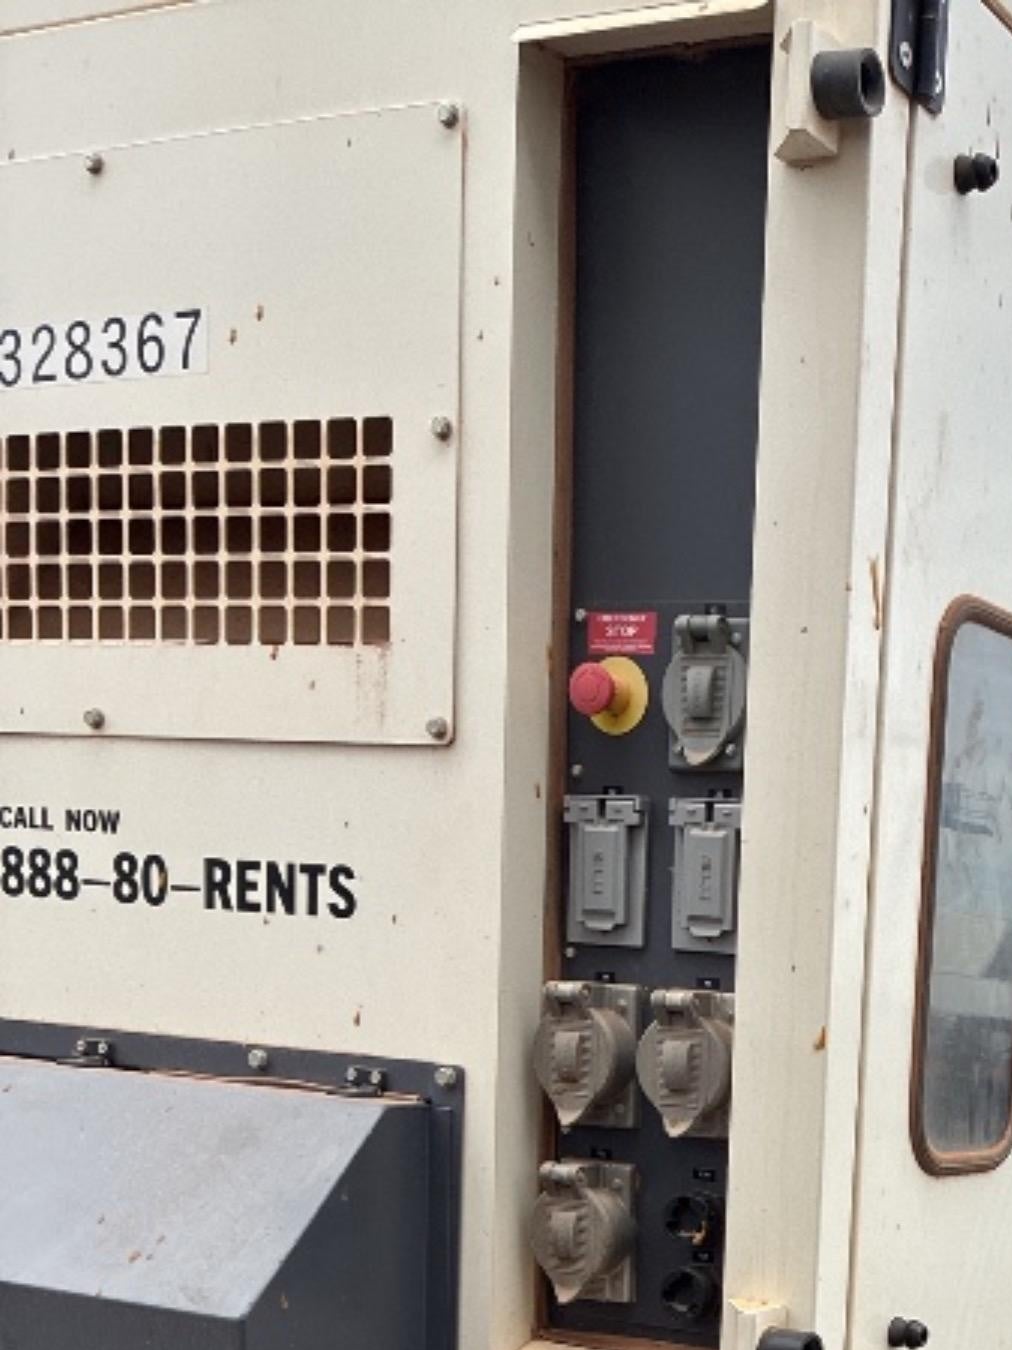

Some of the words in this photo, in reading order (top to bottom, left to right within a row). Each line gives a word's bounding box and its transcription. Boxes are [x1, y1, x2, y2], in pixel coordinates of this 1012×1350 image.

[0, 309, 202, 387] 328367
[0, 806, 54, 831] CALL
[65, 809, 120, 834] NOW
